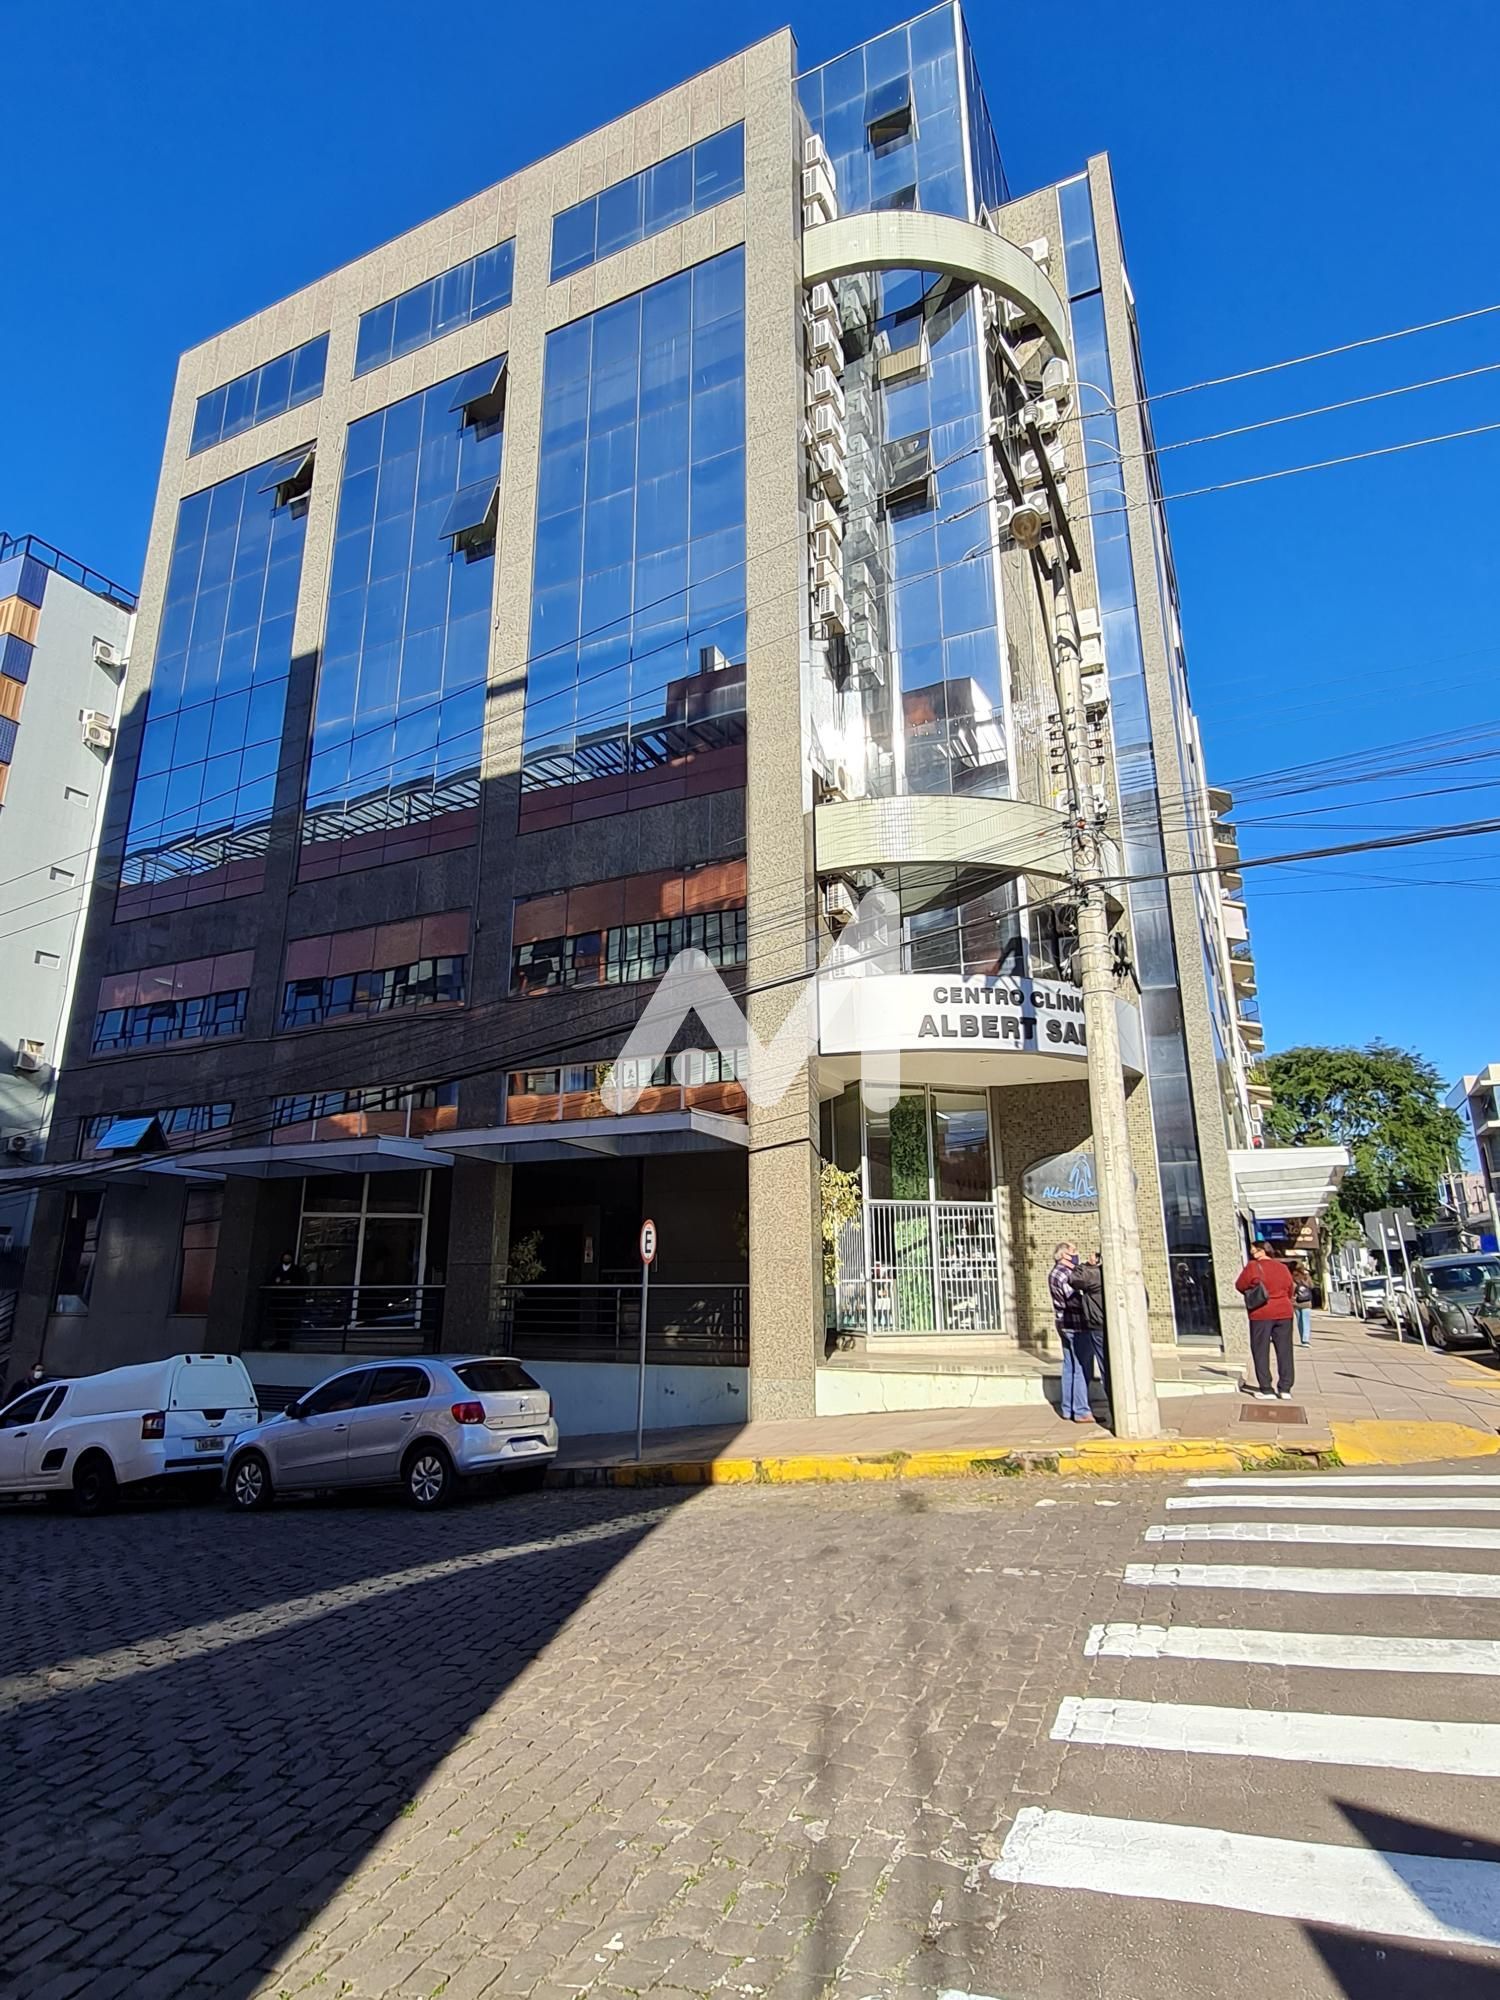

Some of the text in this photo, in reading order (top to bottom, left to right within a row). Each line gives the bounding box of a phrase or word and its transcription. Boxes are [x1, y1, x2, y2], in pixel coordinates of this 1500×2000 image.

[933, 986, 1024, 1007] CENTRO
[918, 1015, 1037, 1040] ALBERT
[645, 1230, 652, 1254] E
